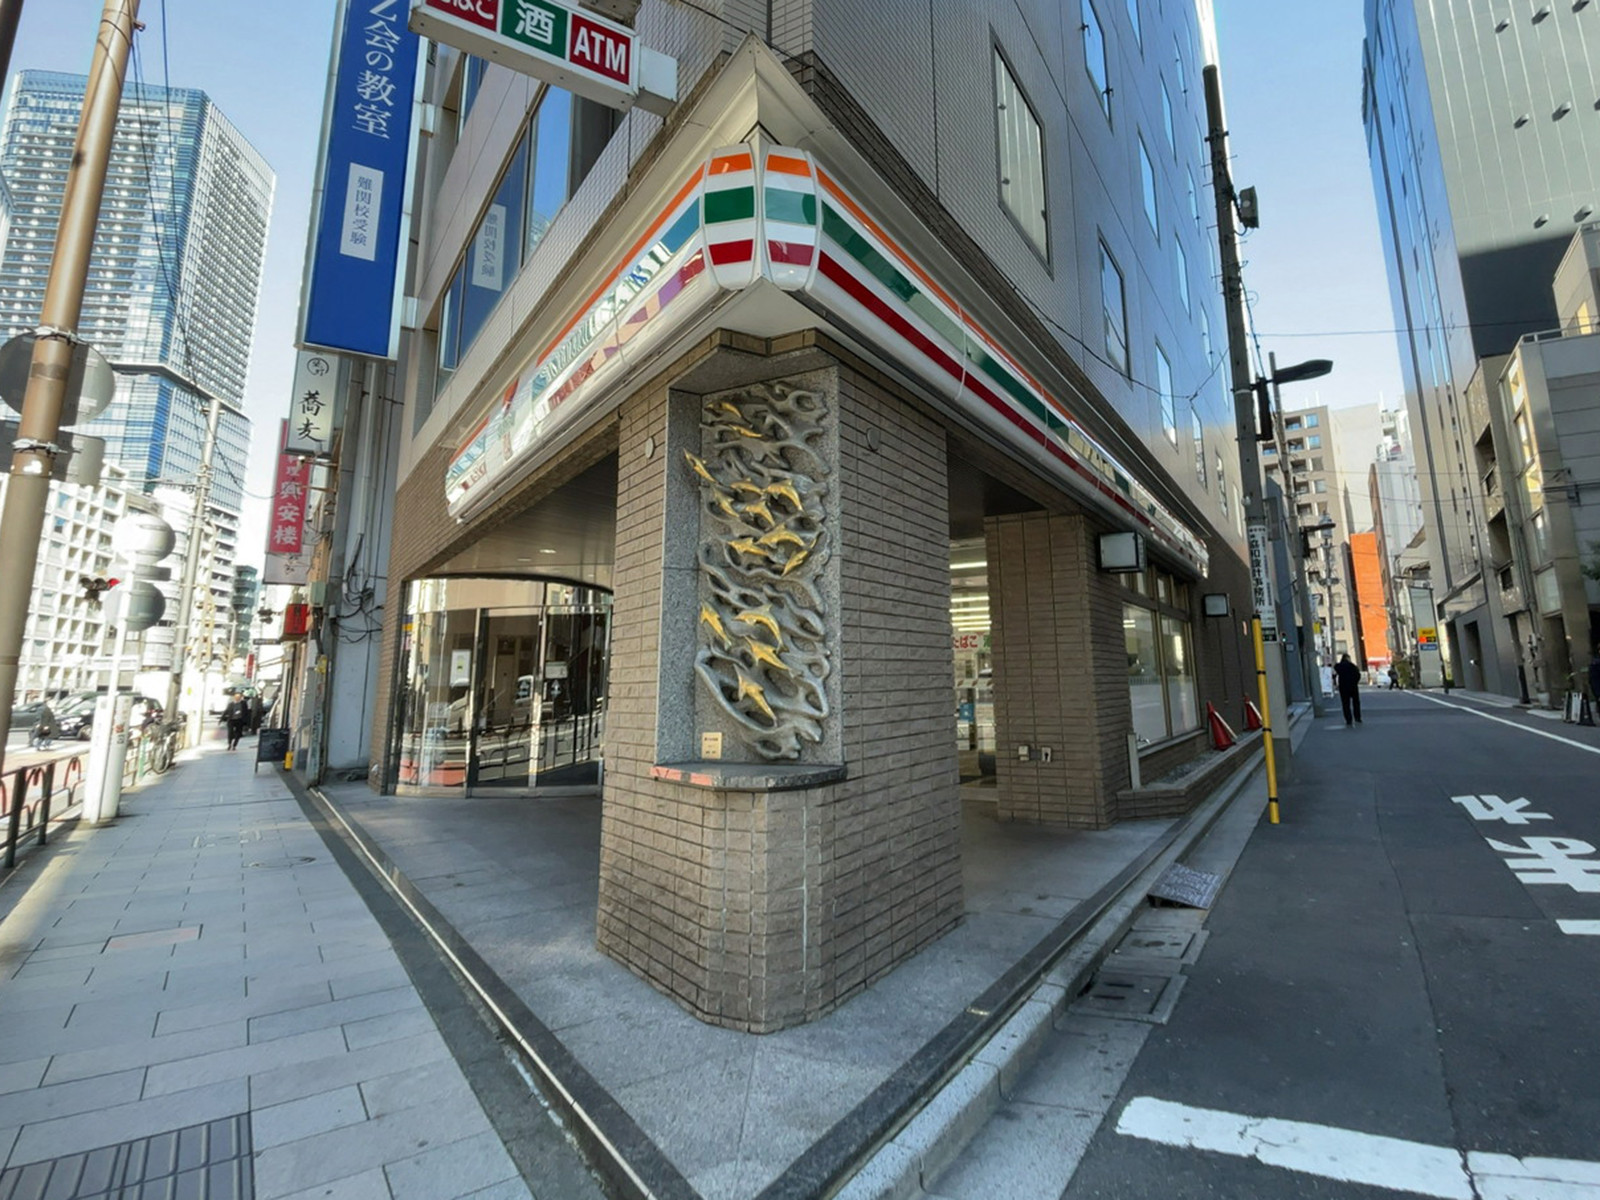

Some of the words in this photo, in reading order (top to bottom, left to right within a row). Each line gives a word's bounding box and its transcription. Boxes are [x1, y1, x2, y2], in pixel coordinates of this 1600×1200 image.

[515, 0, 556, 45] 酒
[573, 26, 627, 75] ATM
[349, 176, 373, 247] 難関校受験
[297, 390, 327, 442] 蕎麦
[1450, 794, 1600, 935] まれ
